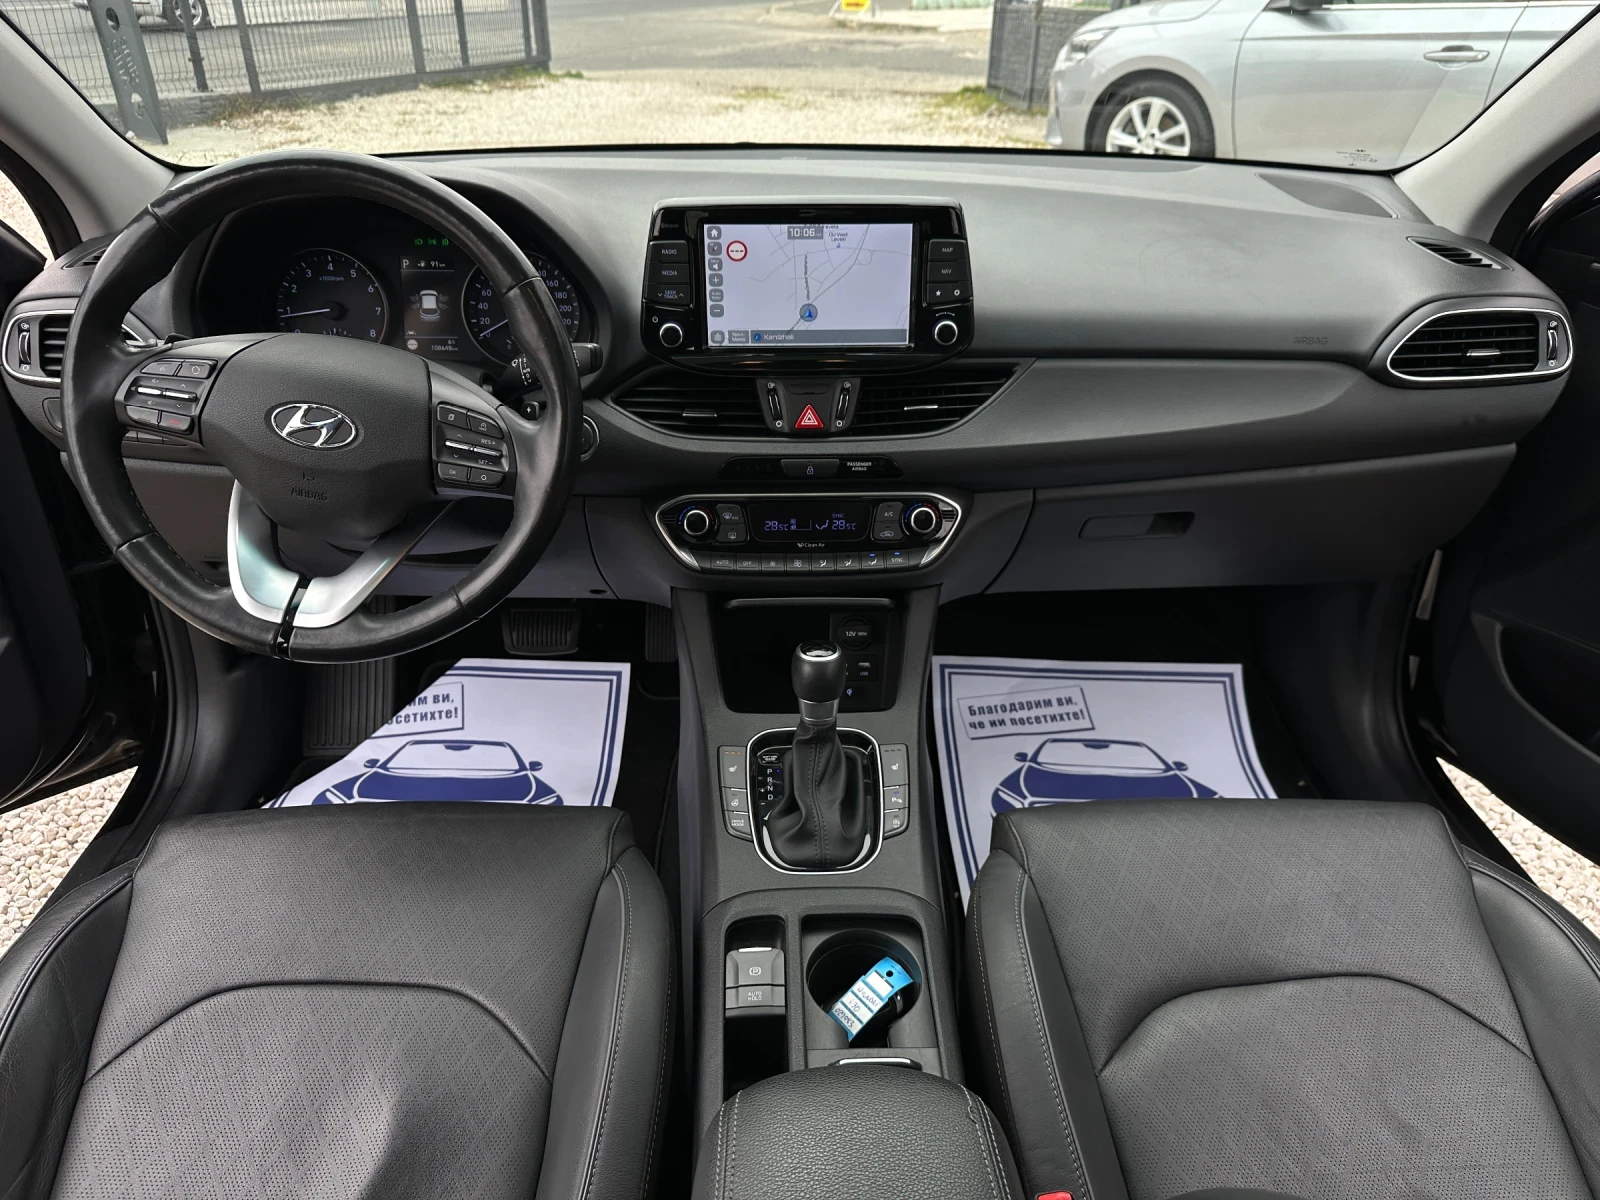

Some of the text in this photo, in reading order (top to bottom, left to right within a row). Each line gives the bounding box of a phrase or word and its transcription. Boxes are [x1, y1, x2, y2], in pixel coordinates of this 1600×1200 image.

[789, 228, 815, 237] 10:06
[402, 260, 409, 268] P
[292, 285, 297, 293] 2
[368, 285, 374, 293] 6
[554, 291, 567, 299] 180
[478, 302, 488, 310] 40
[480, 317, 490, 325] 20
[370, 329, 376, 337] 8
[1294, 337, 1328, 345] AIRBAG
[291, 487, 328, 500] AIRBAG
[968, 698, 1053, 716] Благодарим
[969, 709, 1085, 730] че ни посетихте!
